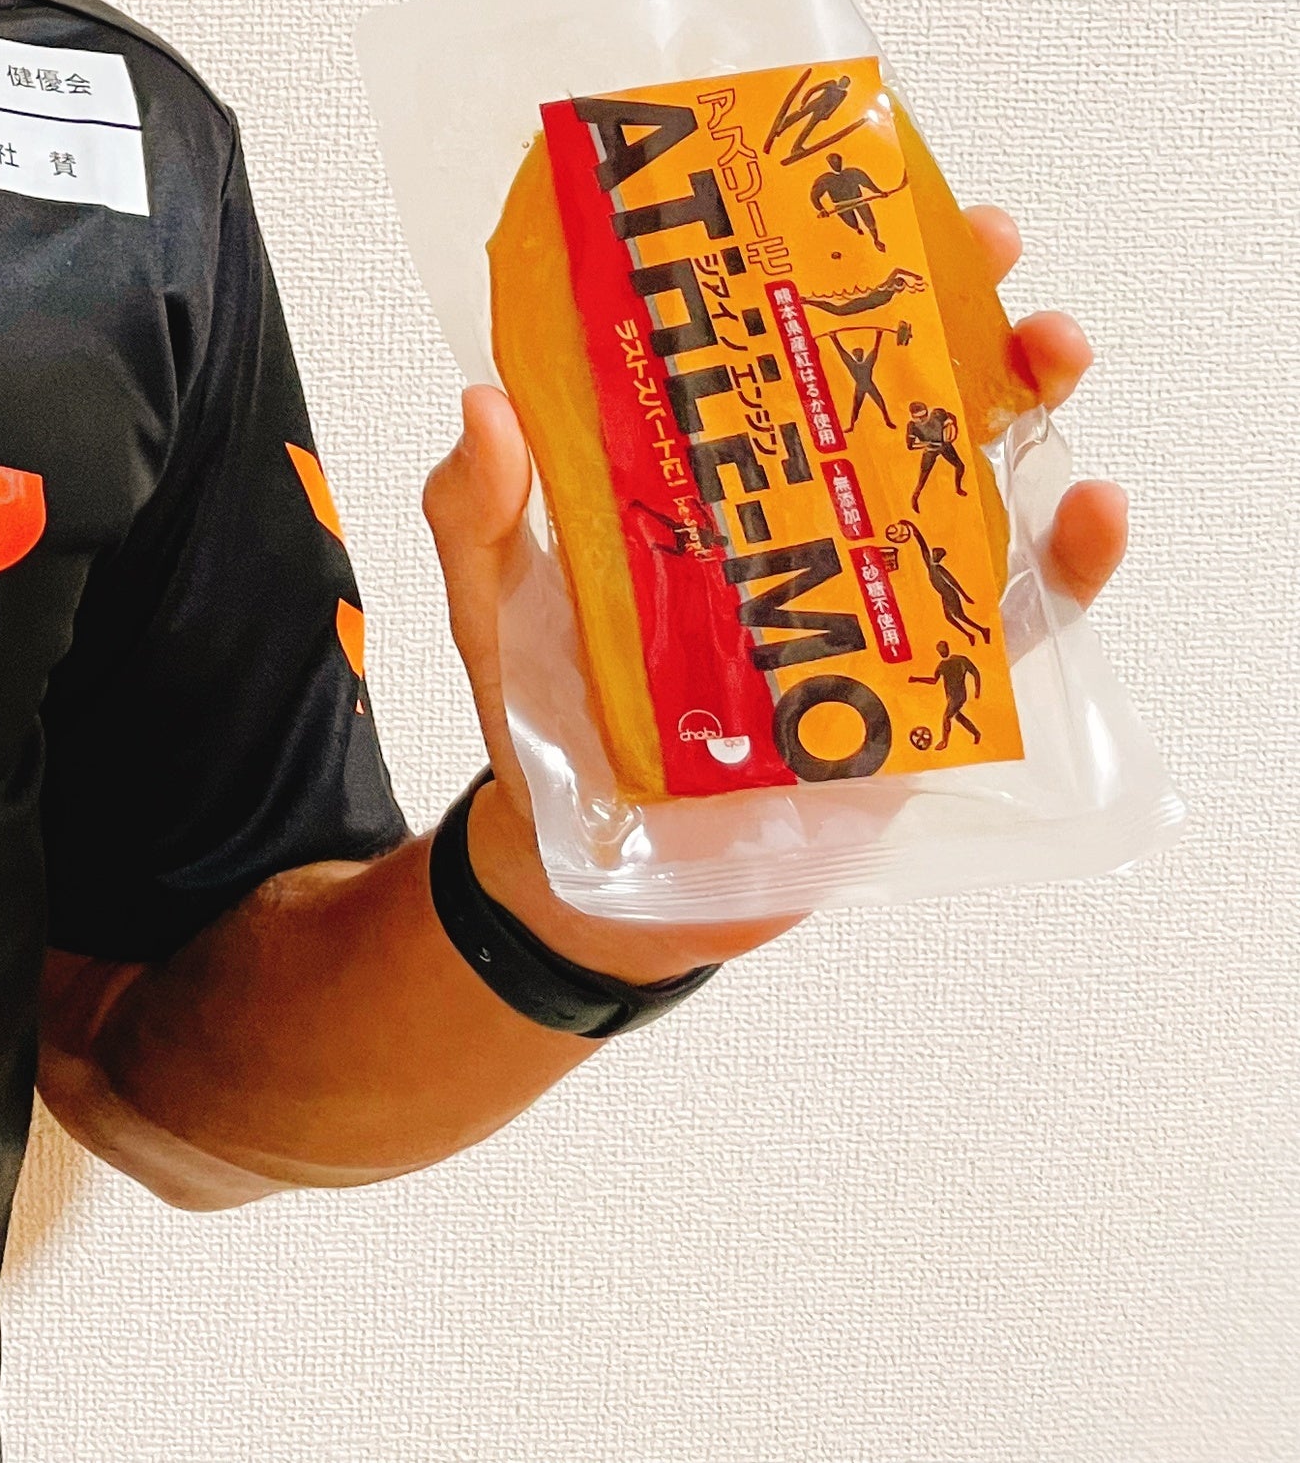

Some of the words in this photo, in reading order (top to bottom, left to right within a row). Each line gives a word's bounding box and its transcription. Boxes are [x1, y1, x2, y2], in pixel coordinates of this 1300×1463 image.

[6, 64, 93, 96] 健優会
[696, 87, 793, 277] アスリーモ
[571, 96, 893, 783] ATHLE-MO
